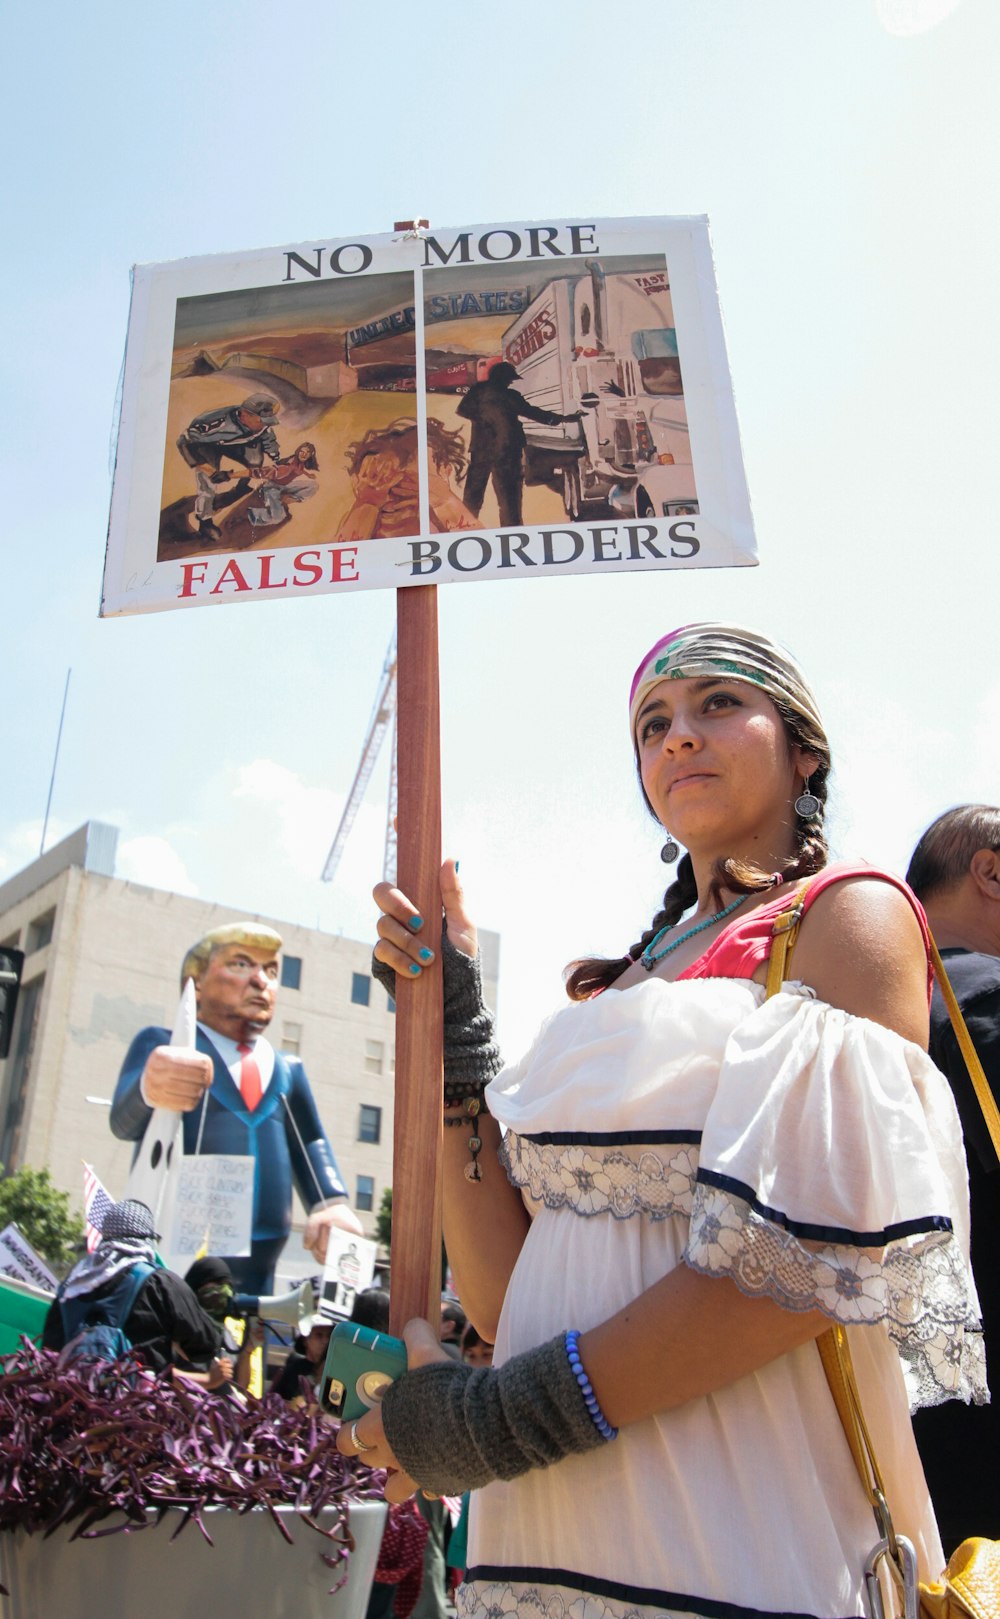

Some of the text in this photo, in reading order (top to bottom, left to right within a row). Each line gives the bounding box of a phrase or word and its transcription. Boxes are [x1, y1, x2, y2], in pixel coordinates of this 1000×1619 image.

[282, 224, 600, 282] NO MORE
[633, 273, 665, 287] FAST
[350, 290, 524, 345] UNITED STATES
[177, 521, 701, 599] FALSE BORDERS
